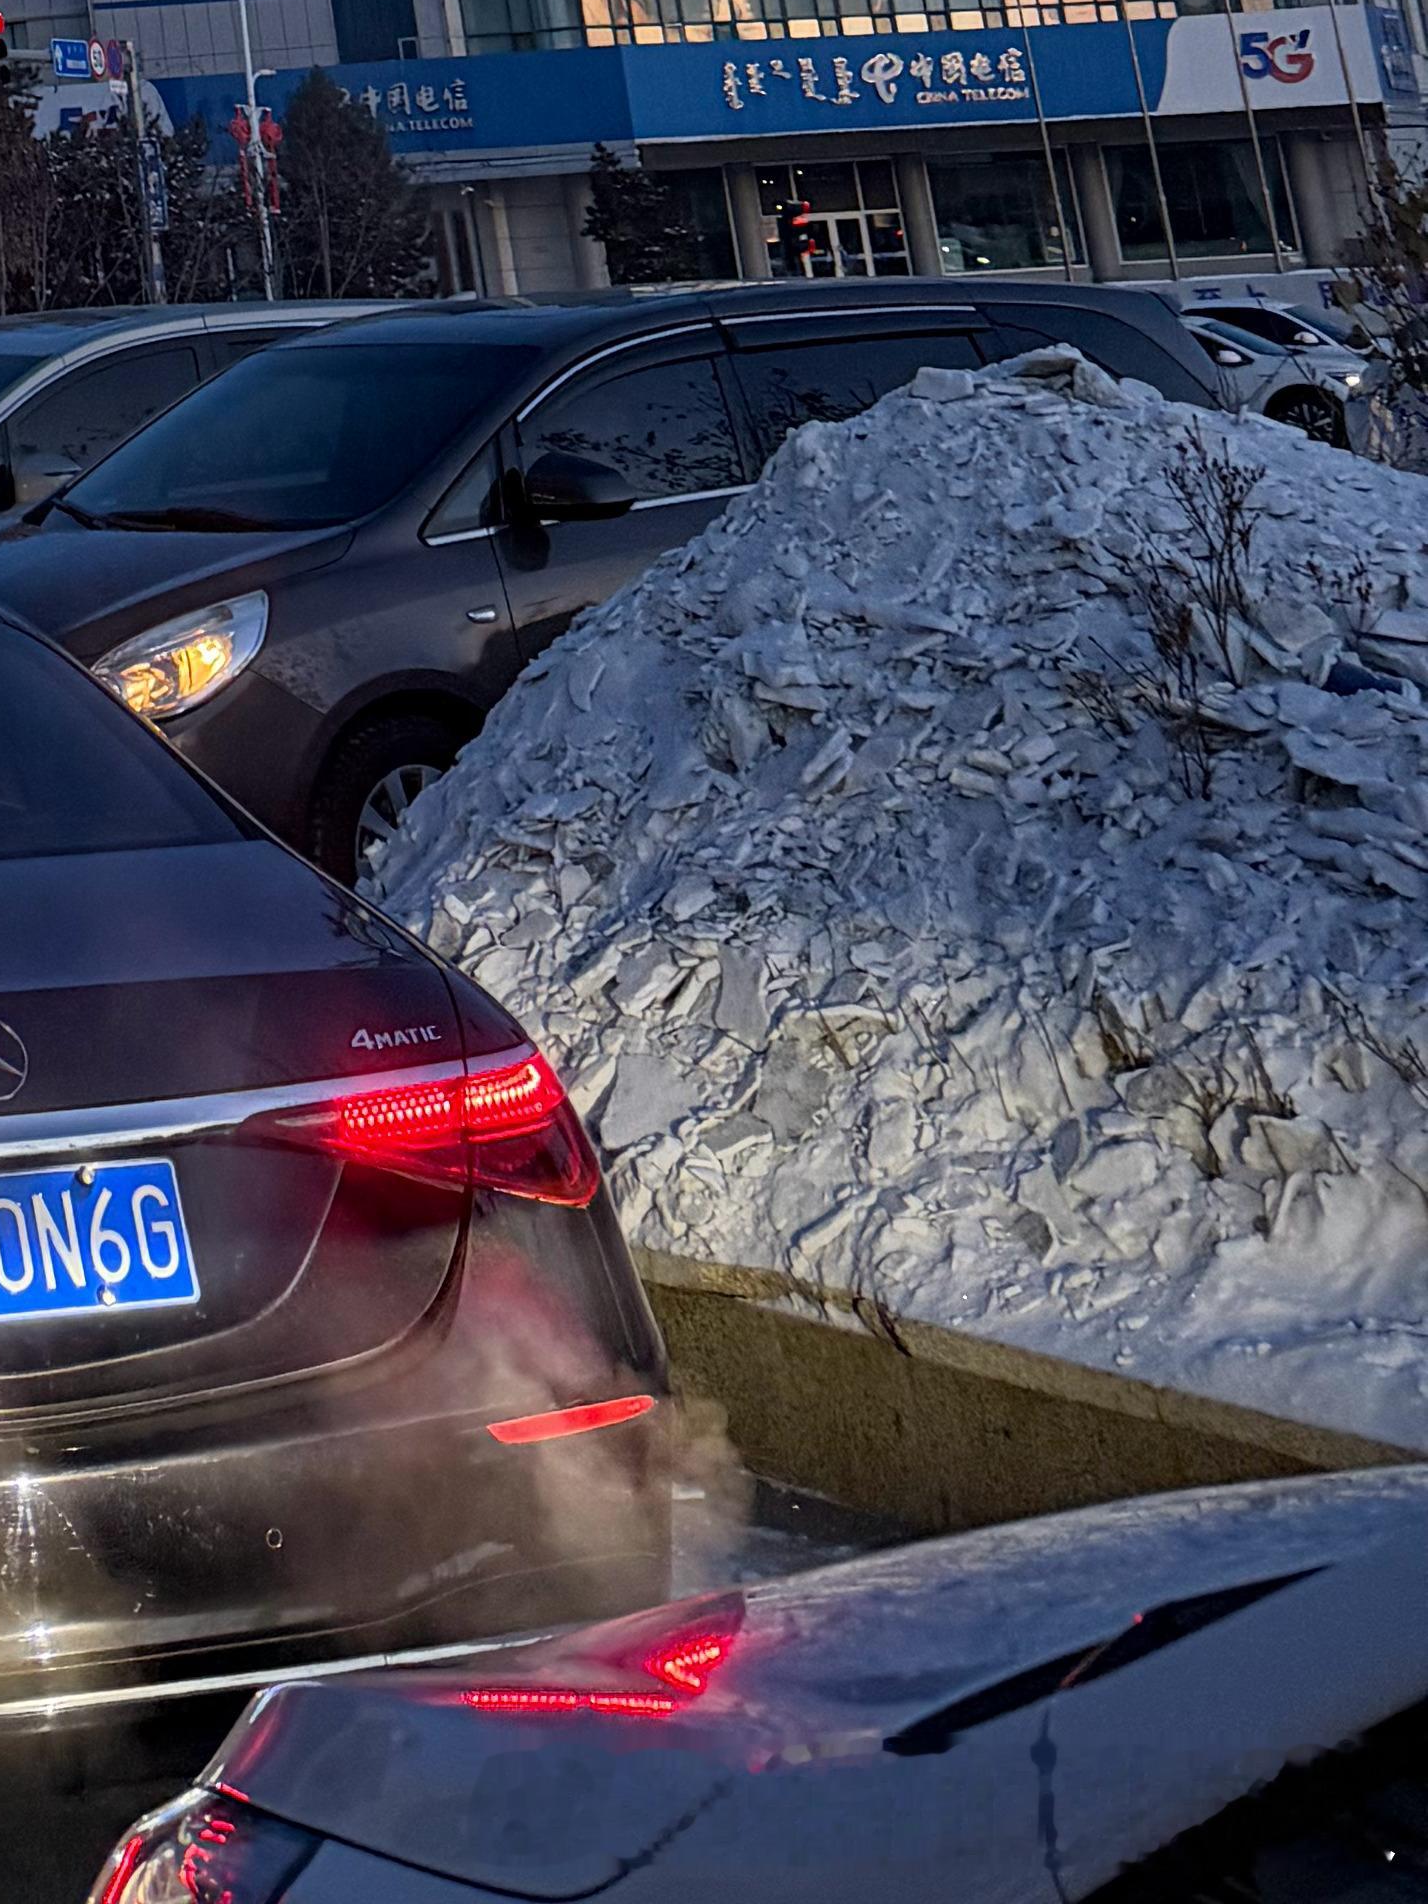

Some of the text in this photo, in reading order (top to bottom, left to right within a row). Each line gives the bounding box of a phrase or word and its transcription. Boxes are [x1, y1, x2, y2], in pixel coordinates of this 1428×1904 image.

[910, 47, 1026, 88] 中国电信
[1239, 29, 1316, 84] 5G
[359, 78, 469, 119] 中国电信
[351, 1025, 442, 1050] 4MATIC
